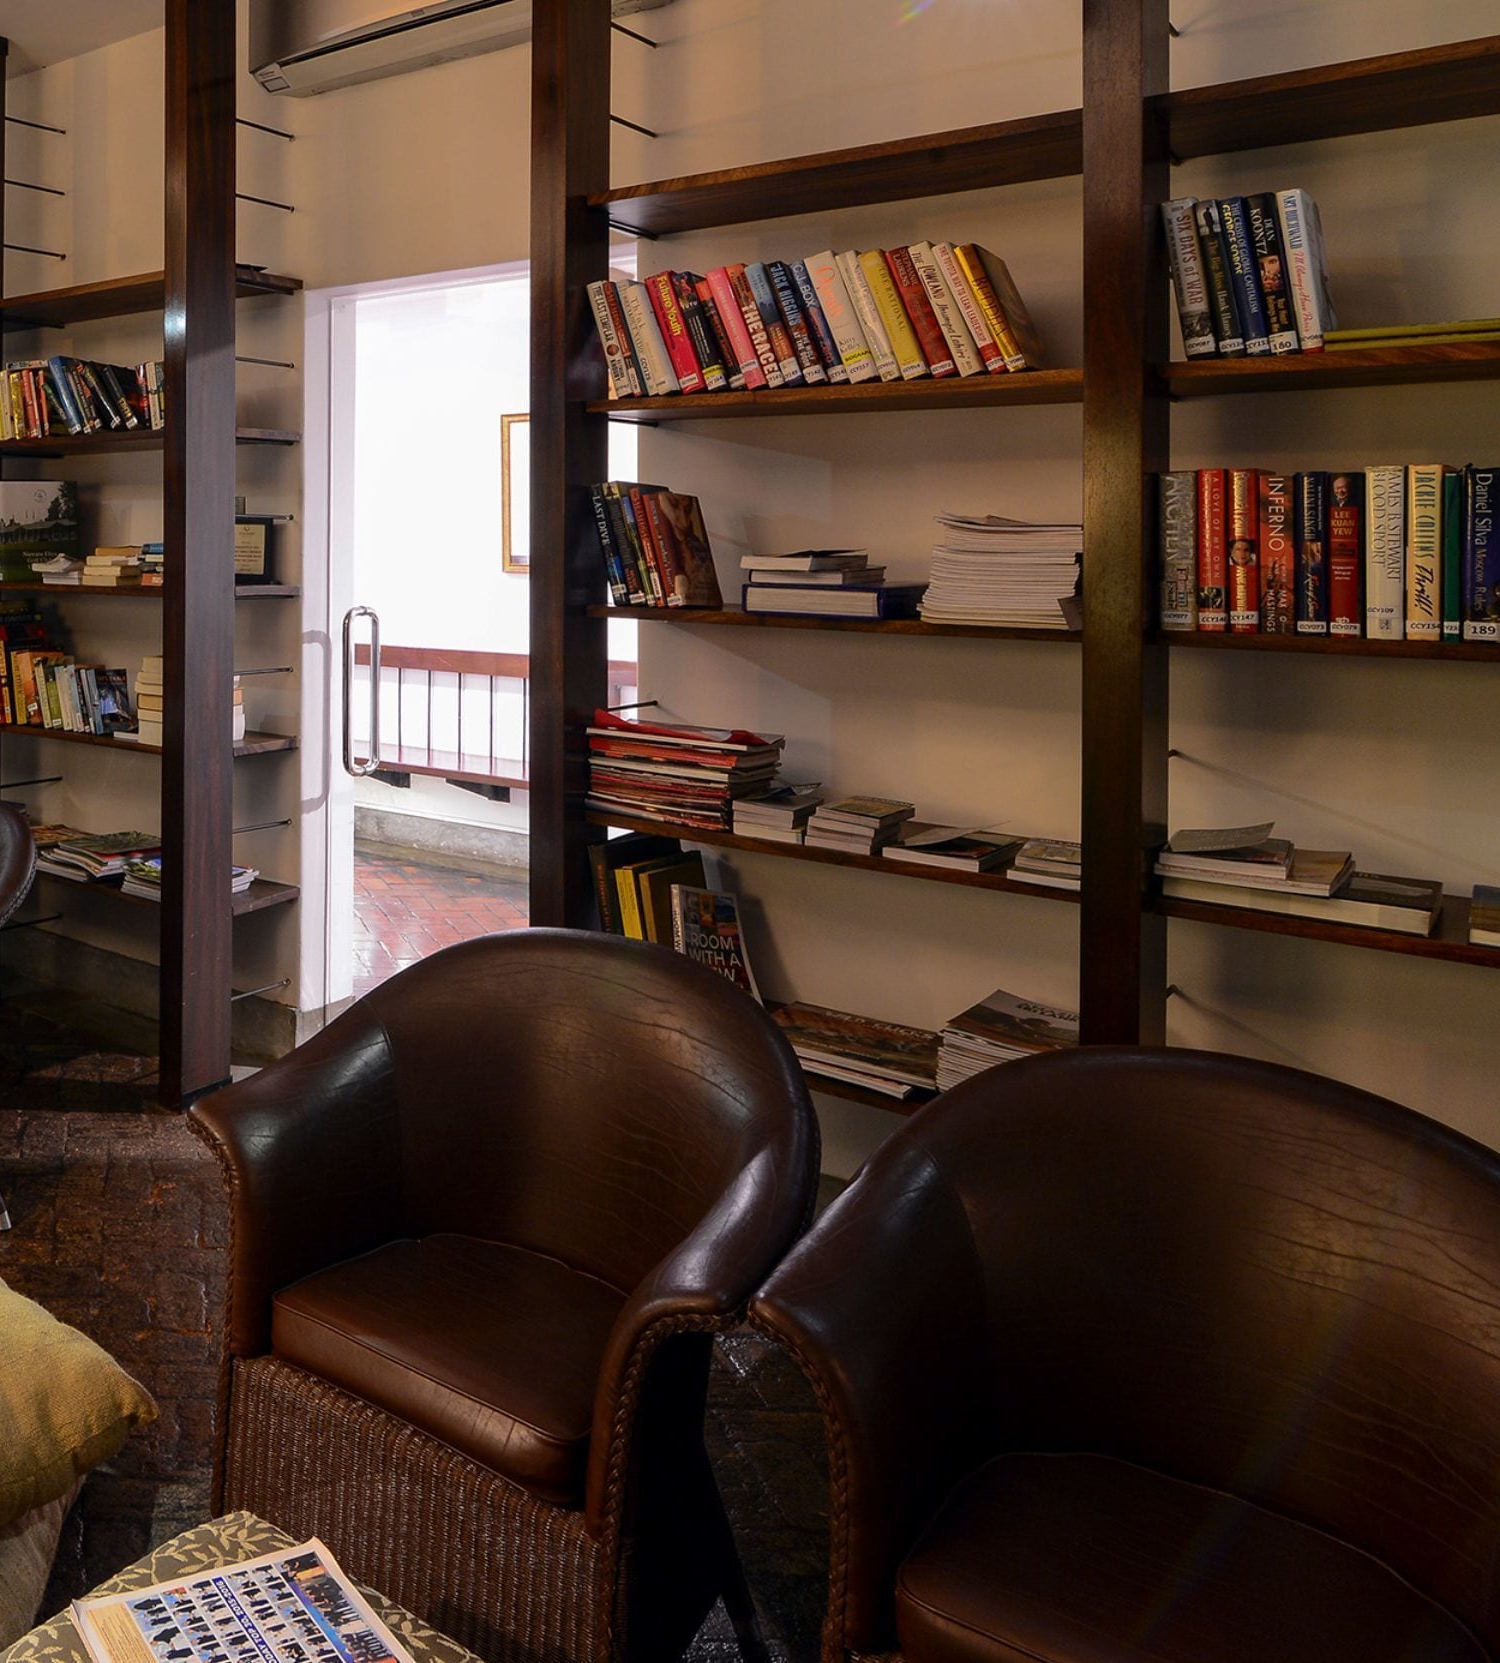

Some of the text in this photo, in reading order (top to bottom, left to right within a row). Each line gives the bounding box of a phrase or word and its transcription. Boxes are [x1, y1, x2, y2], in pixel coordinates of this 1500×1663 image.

[1175, 215, 1192, 233] SIX
[1233, 216, 1244, 238] CRISIS
[1249, 207, 1268, 256] KOONTZ
[1263, 218, 1275, 241] DEAN
[911, 250, 924, 265] THE
[937, 245, 949, 257] THE
[1178, 235, 1197, 264] DAYS
[1239, 248, 1251, 274] GLOBAL
[892, 252, 911, 287] LAURENS
[898, 248, 919, 285] STEPHANIE
[942, 256, 957, 277] TOYOTA
[950, 275, 962, 289] WAY
[1183, 265, 1199, 277] of
[591, 286, 604, 300] THE
[770, 264, 802, 326] JACK HIGGINS
[799, 284, 816, 308] BOX
[877, 265, 906, 331] THE RATIONAL
[917, 262, 946, 303] LOWLAND
[1186, 279, 1204, 305] WAR
[1244, 275, 1258, 313] CAPITALISM
[595, 299, 608, 316] LAST
[656, 274, 674, 308] Future
[666, 307, 682, 336] Youth
[959, 294, 972, 311] LEAN
[971, 275, 1009, 337] BUDDHA
[1216, 290, 1230, 311] Hank
[599, 314, 615, 342] TEMPLAR
[933, 299, 957, 334] Jhumpa
[965, 309, 987, 343] LEADERSHIP
[740, 301, 779, 374] THE RACE
[1271, 340, 1291, 351] 160
[592, 495, 610, 546] LAST DIVE
[1165, 476, 1192, 560] ARCHER
[1267, 478, 1284, 550] INFERNO
[1303, 510, 1316, 539] SINGH
[1371, 472, 1385, 567] BLOOD SPORT
[1415, 471, 1435, 558] JACKIE COLLINS
[1475, 473, 1492, 545] Daniel Silva
[1387, 522, 1401, 582] STEWART
[1414, 564, 1433, 616] Thrill!
[1474, 547, 1486, 611] Moscow Rules
[690, 933, 735, 950] ROOM
[688, 948, 742, 968] WITH A
[216, 1579, 244, 1617] 2015-2016
[247, 1626, 263, 1645] TOP
